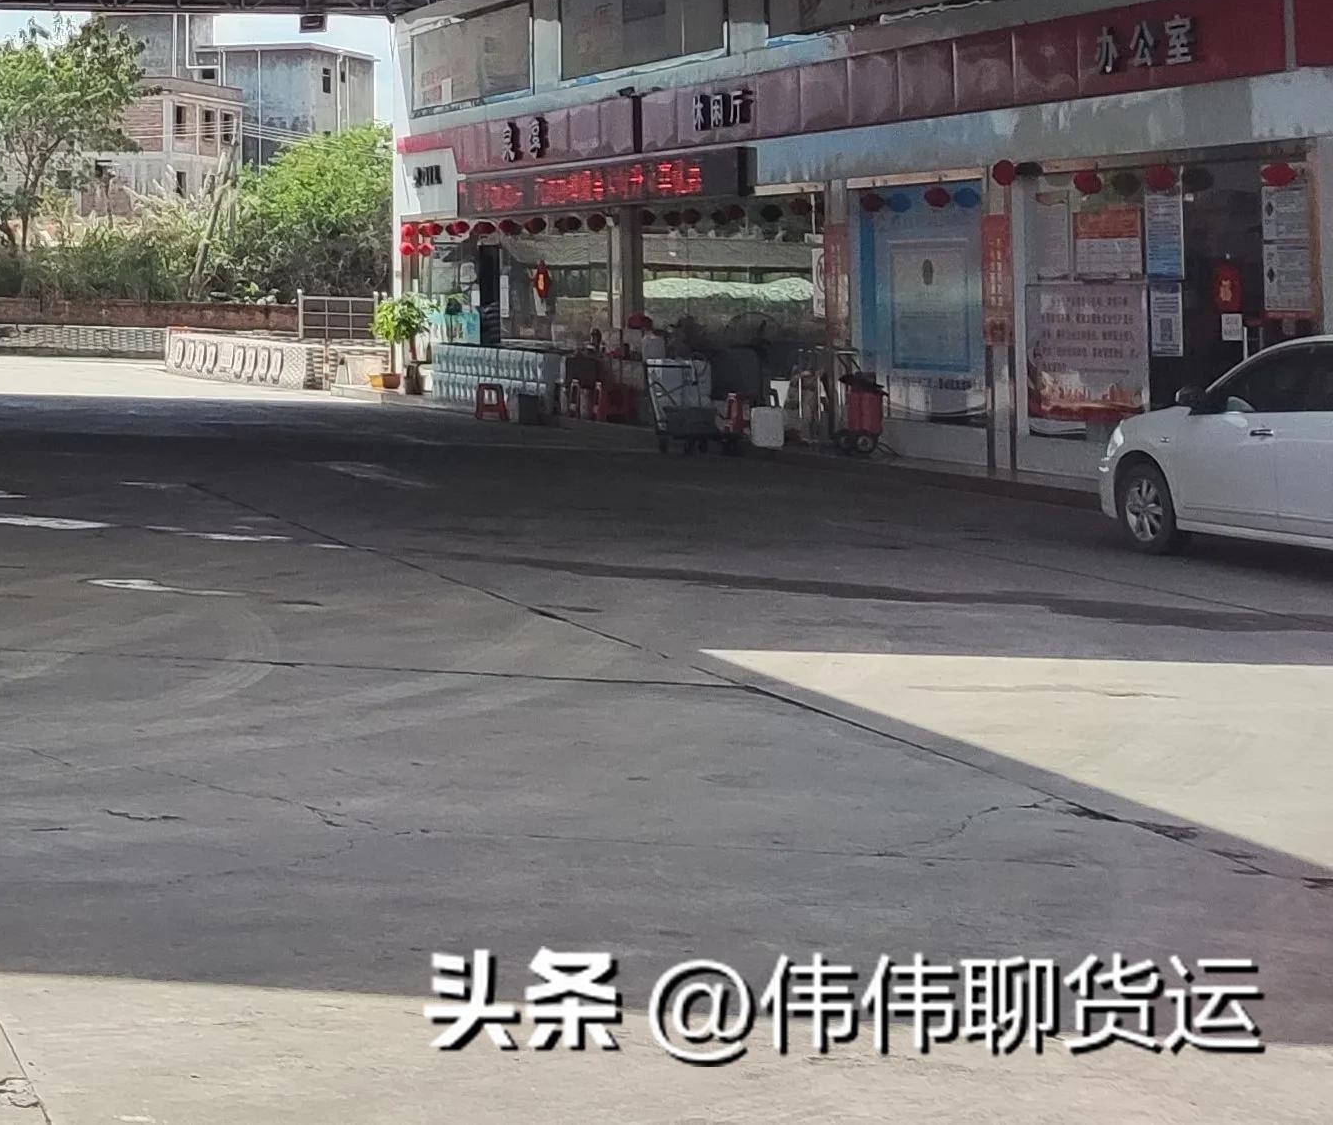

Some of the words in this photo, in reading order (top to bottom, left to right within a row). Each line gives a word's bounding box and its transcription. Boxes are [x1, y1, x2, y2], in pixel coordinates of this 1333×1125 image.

[1094, 13, 1193, 73] 办公室
[692, 90, 745, 131] 休闲厅
